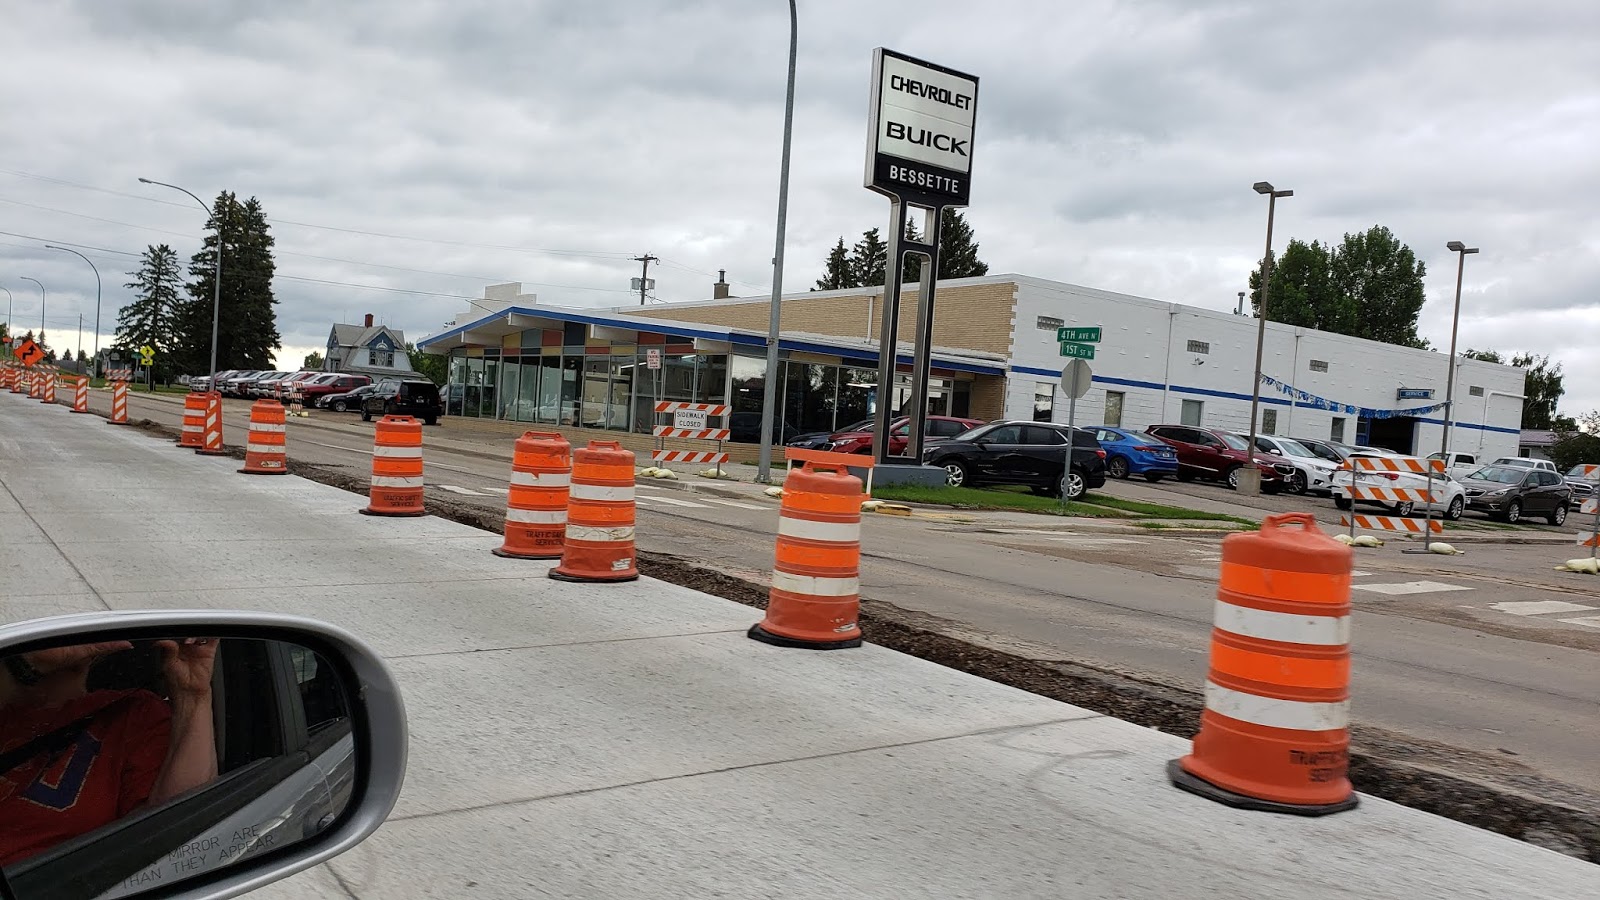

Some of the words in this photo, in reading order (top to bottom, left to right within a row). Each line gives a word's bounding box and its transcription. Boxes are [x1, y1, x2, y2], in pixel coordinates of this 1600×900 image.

[891, 74, 972, 111] CHEVROLET
[886, 121, 968, 157] BUICK
[889, 165, 959, 194] BESSETTE
[1061, 330, 1076, 340] 4TH
[1078, 332, 1089, 340] AVE
[1091, 332, 1097, 340] N
[1065, 345, 1078, 354] 1ST
[676, 411, 705, 420] SIDEWALK
[679, 420, 702, 428] CLOSED
[525, 530, 551, 538] TRAFFIC
[168, 836, 221, 862] MIRROR
[231, 824, 260, 843] ARE
[122, 869, 162, 889] THAN
[171, 854, 208, 874] THEY
[218, 834, 275, 861] APPEAR
